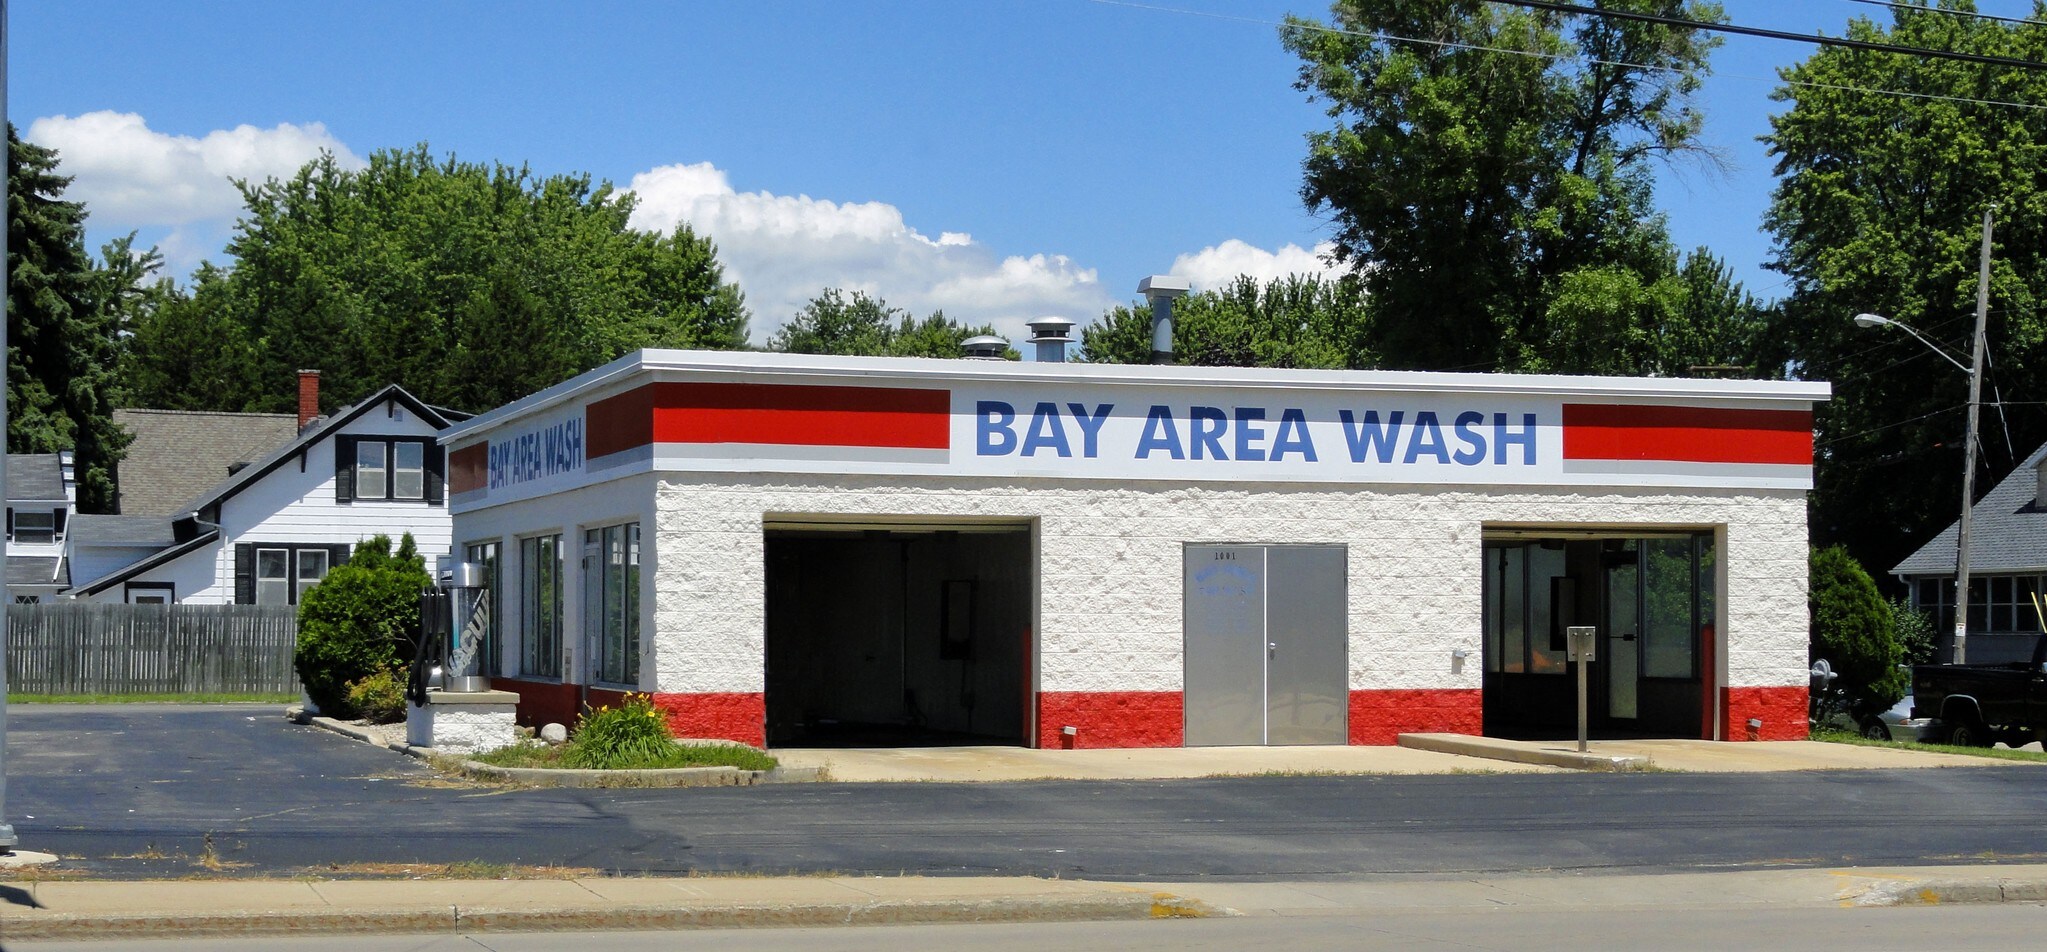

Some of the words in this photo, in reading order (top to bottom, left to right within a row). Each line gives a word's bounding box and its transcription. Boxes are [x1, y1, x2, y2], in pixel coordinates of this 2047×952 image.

[490, 440, 511, 490] BAY
[512, 431, 542, 485] AREA
[544, 417, 582, 477] WASH
[976, 400, 1115, 458] BAY
[1134, 404, 1319, 463] AREA
[1338, 409, 1538, 466] WASH
[1214, 552, 1237, 560] 1001
